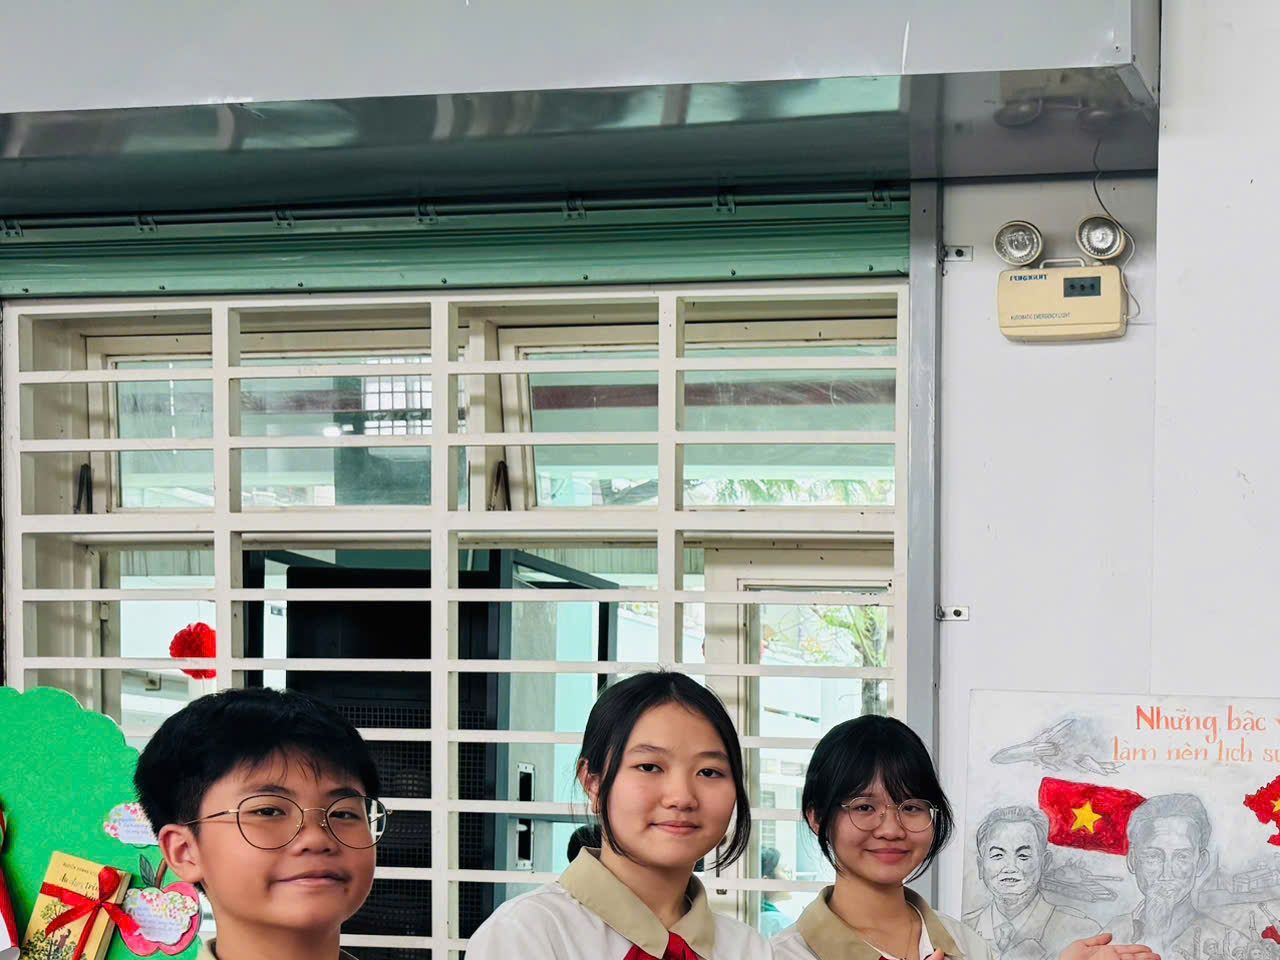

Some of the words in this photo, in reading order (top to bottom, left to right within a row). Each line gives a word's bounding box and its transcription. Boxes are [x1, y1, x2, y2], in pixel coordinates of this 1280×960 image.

[1135, 704, 1219, 743] Những
[1227, 705, 1267, 738] bậc
[1112, 736, 1157, 762] làm
[1217, 739, 1253, 767] lịch
